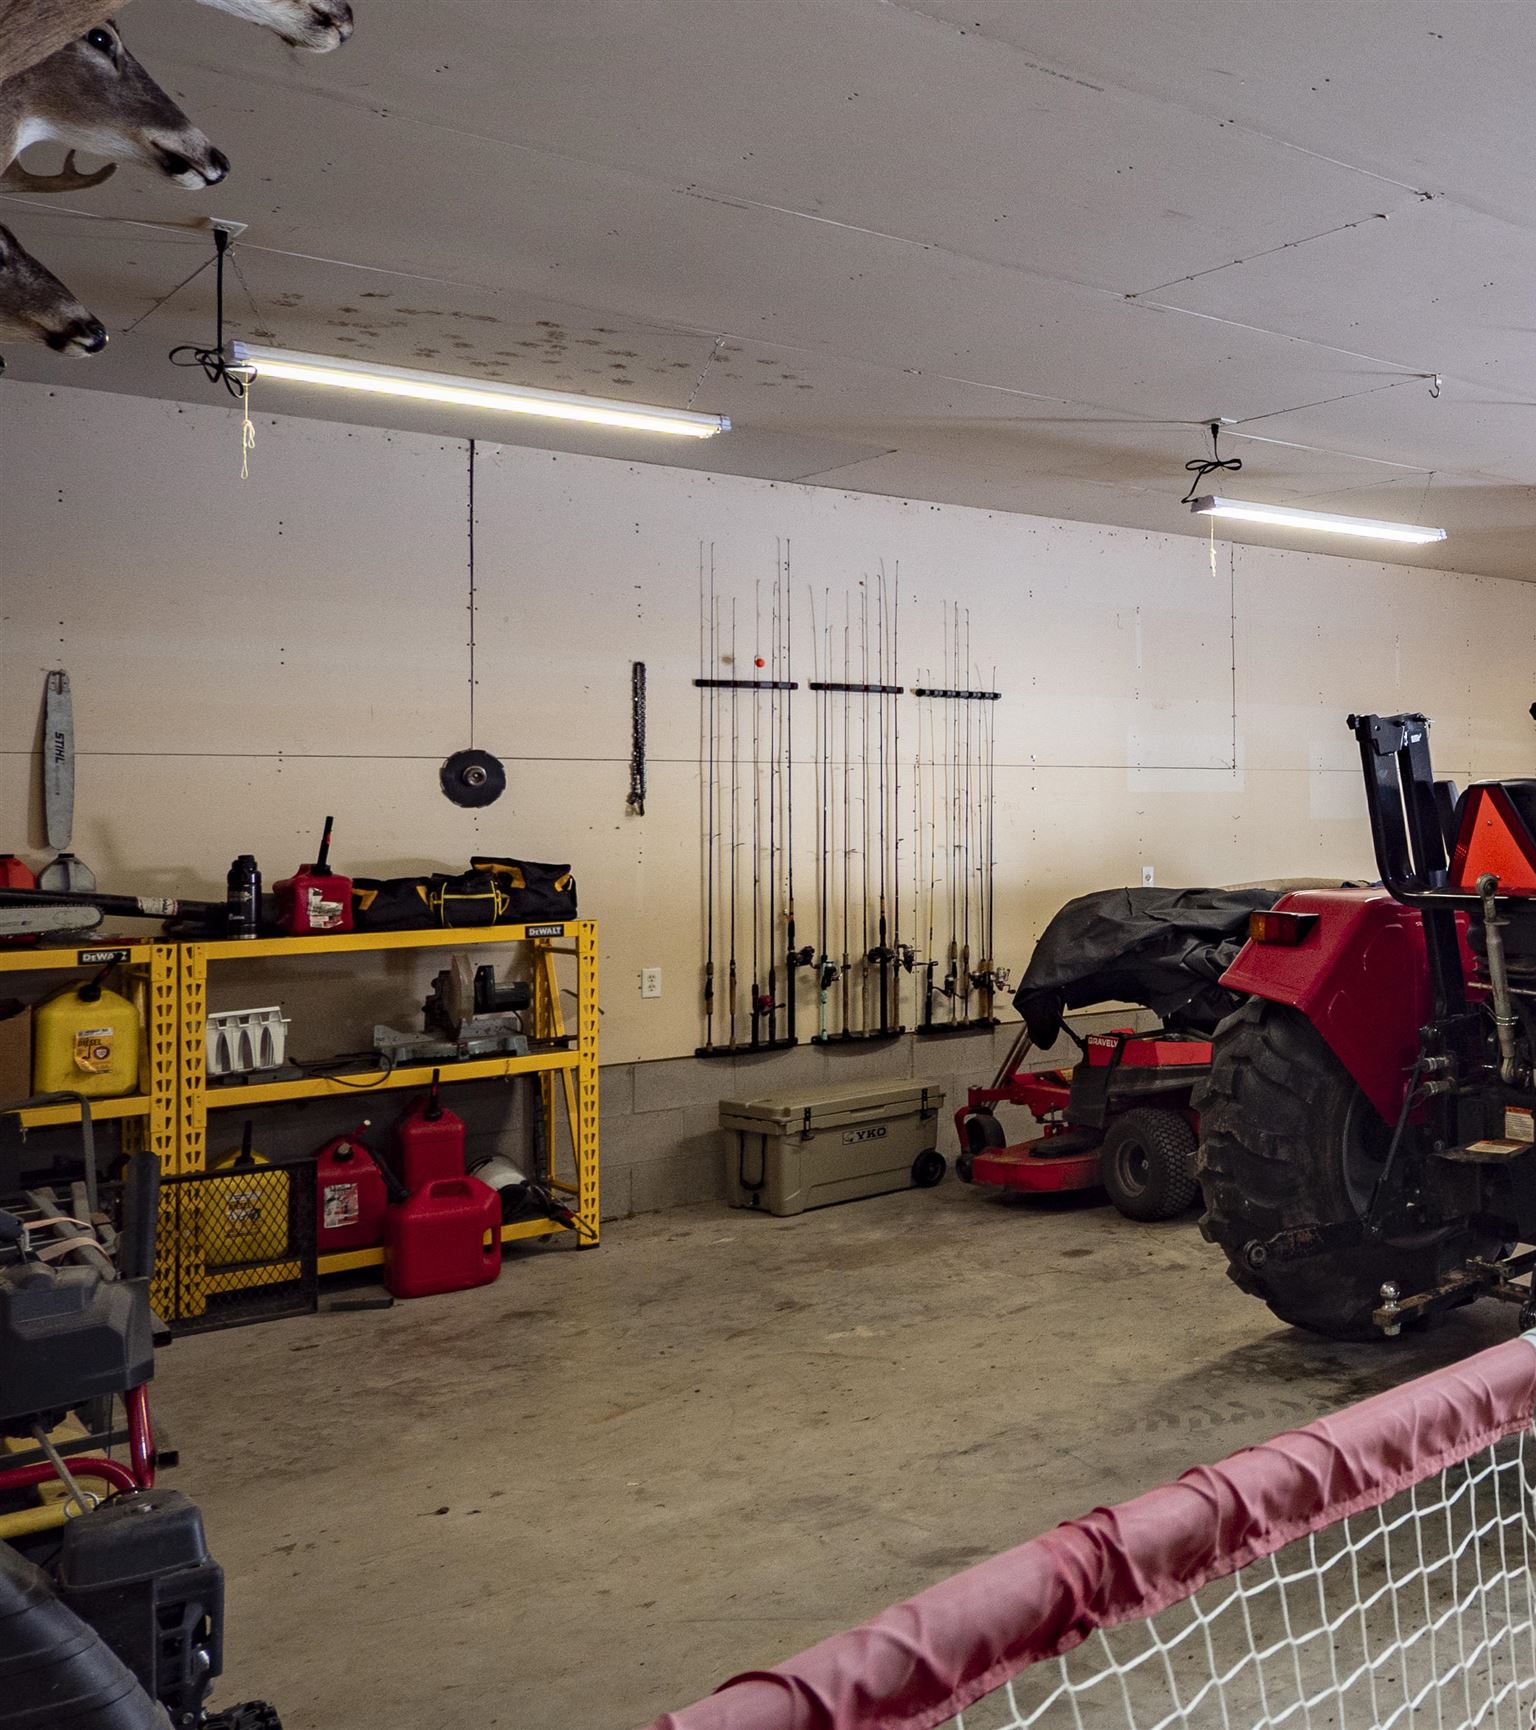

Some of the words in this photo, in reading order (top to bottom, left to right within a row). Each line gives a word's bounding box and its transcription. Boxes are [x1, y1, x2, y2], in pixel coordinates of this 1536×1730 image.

[55, 731, 65, 764] STIHL
[1088, 1036, 1118, 1048] GRAVELY
[856, 1127, 887, 1140] YKO
